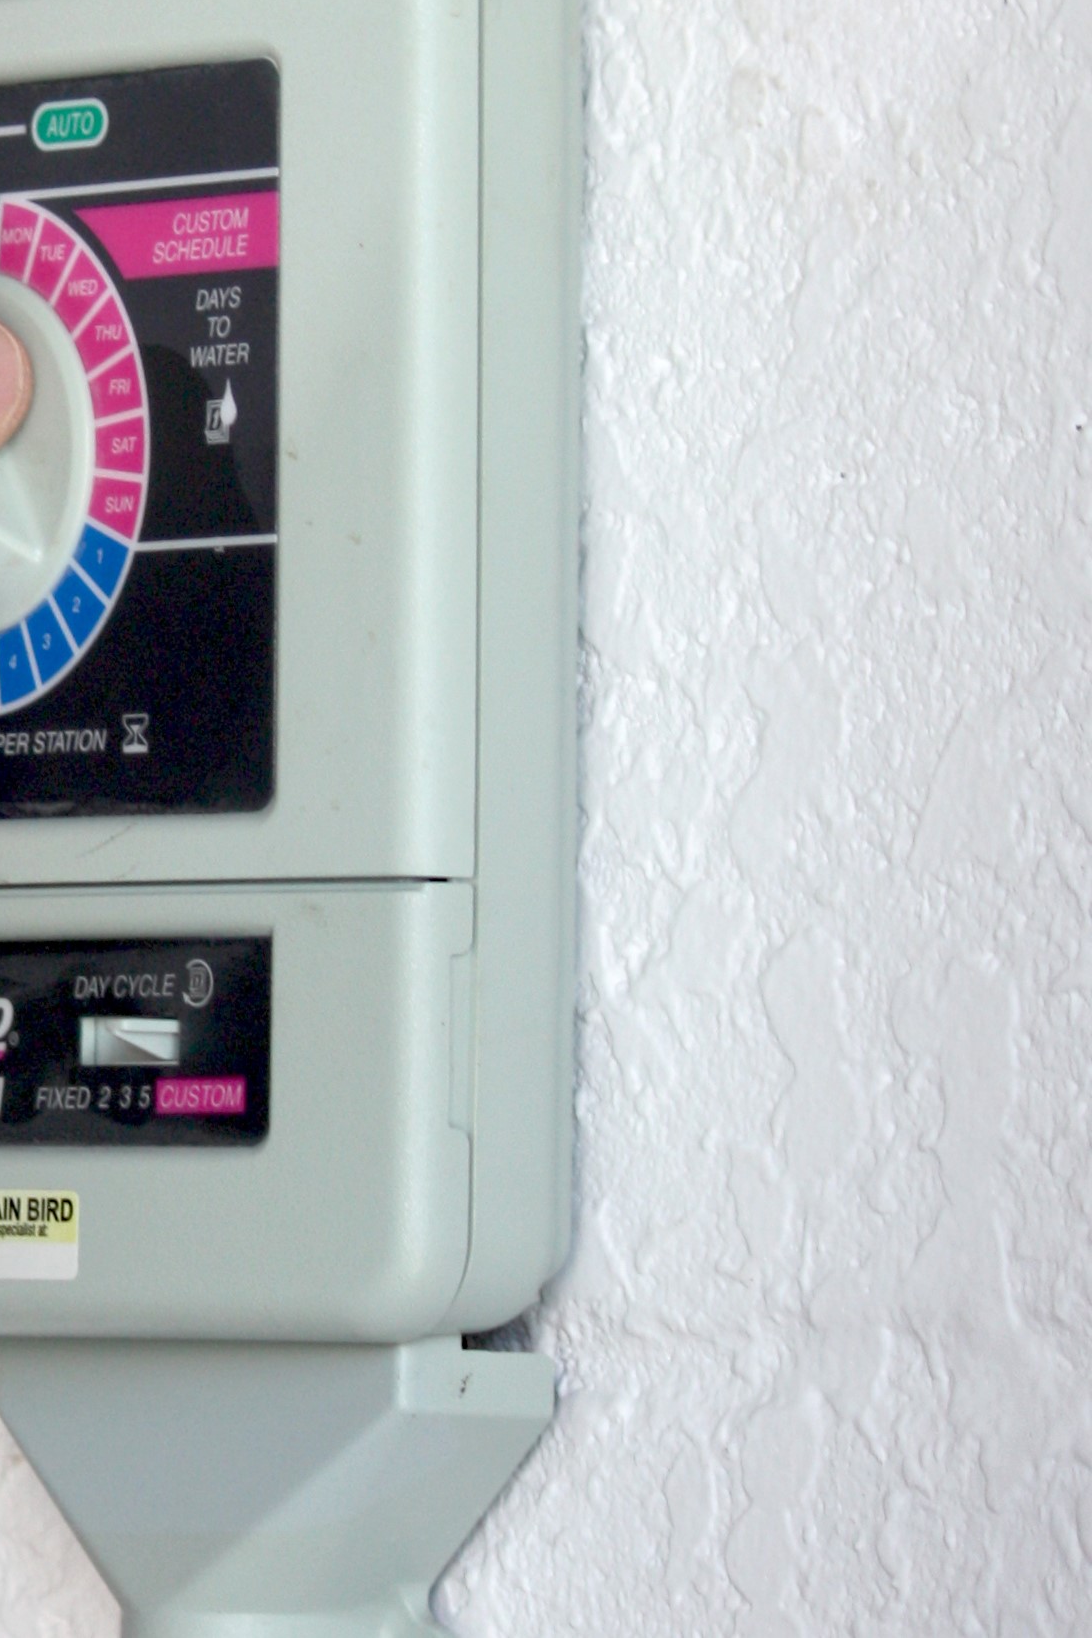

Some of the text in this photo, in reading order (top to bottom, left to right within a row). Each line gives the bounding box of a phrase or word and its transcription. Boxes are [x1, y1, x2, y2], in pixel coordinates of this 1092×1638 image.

[46, 111, 95, 137] AUTO
[173, 207, 249, 235] CUSTOM
[1, 228, 34, 244] MON
[40, 244, 66, 261] TUE
[152, 234, 249, 264] SCHEDULE
[68, 279, 98, 296] WED
[195, 286, 242, 311] DAYS
[95, 324, 123, 341] THU
[208, 315, 231, 338] TO
[190, 342, 250, 368] WATER
[109, 378, 131, 395] FRI
[111, 436, 137, 455] SAT
[105, 496, 134, 513] SUN
[96, 547, 104, 564] 1
[72, 596, 81, 613] 2
[42, 633, 52, 650] 3
[8, 654, 17, 670] 4
[33, 728, 107, 754] STATION
[74, 973, 176, 999] DAY CYCLE
[36, 1083, 243, 1110] FIXED 2 3 5 CUSTOM
[27, 1198, 74, 1222] BIRD
